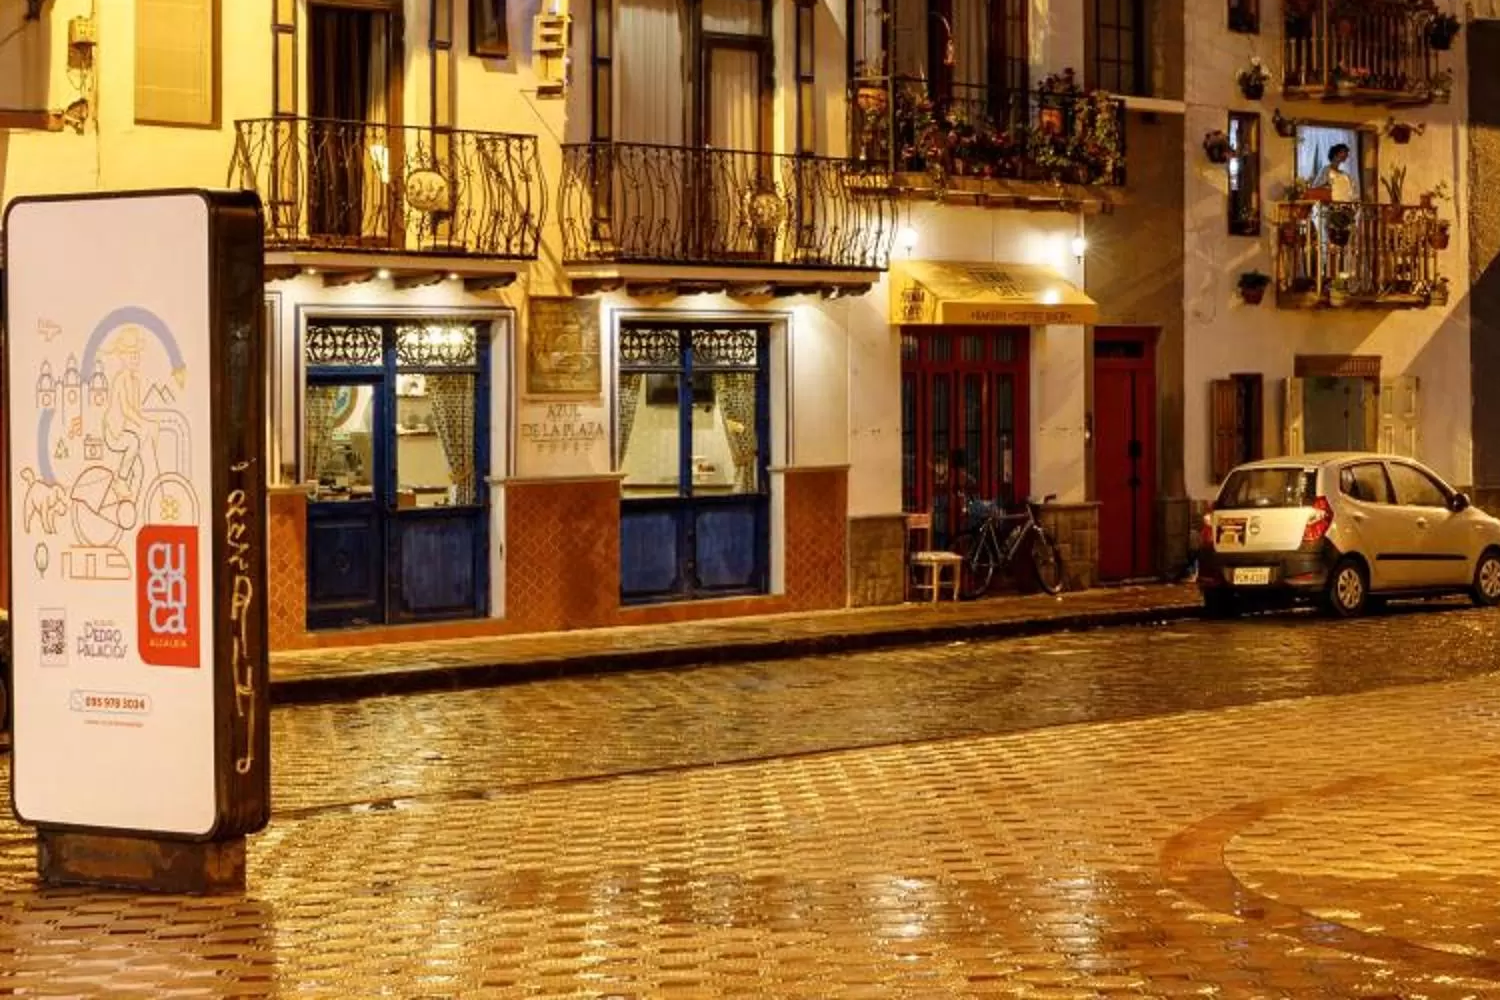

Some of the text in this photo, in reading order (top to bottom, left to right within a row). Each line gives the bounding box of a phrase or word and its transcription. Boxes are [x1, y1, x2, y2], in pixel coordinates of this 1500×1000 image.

[546, 404, 582, 421] AZUL
[520, 421, 605, 440] DE LA PLAZA
